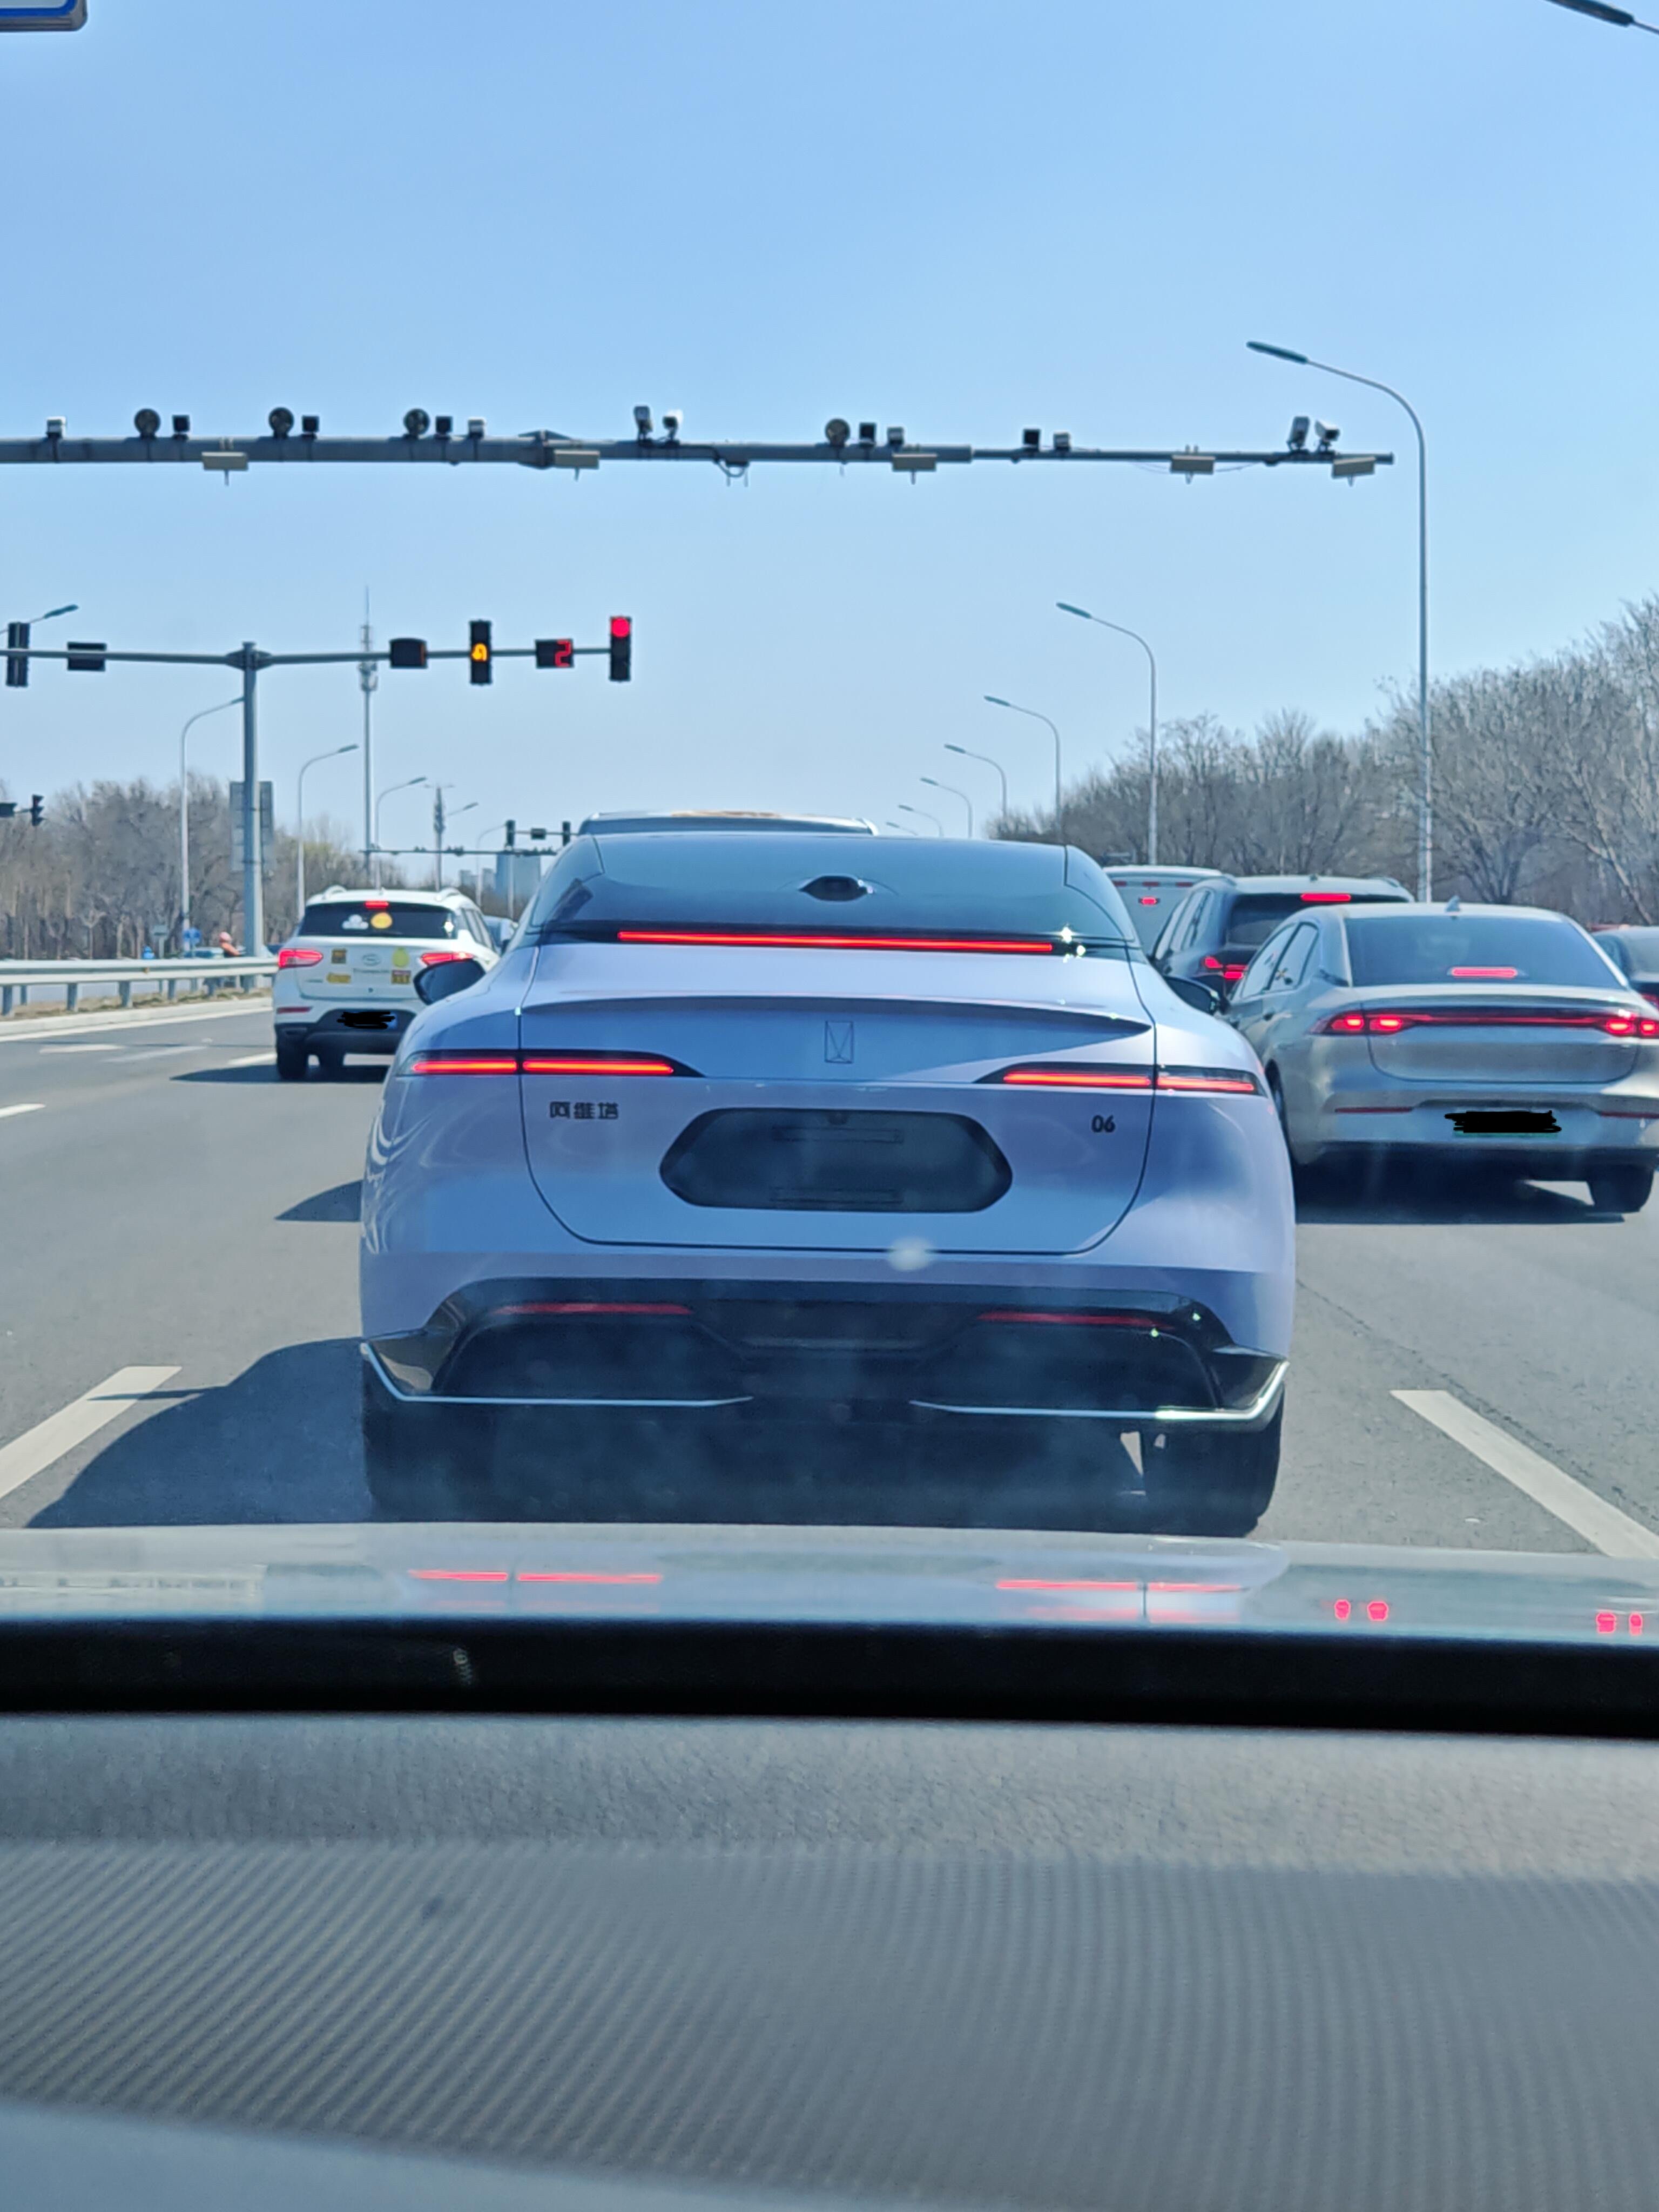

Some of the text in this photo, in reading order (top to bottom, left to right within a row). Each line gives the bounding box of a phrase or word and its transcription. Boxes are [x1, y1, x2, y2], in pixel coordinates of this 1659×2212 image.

[555, 639, 571, 667] 2
[550, 1102, 618, 1119] 阿维塔
[1091, 1115, 1116, 1133] 06
